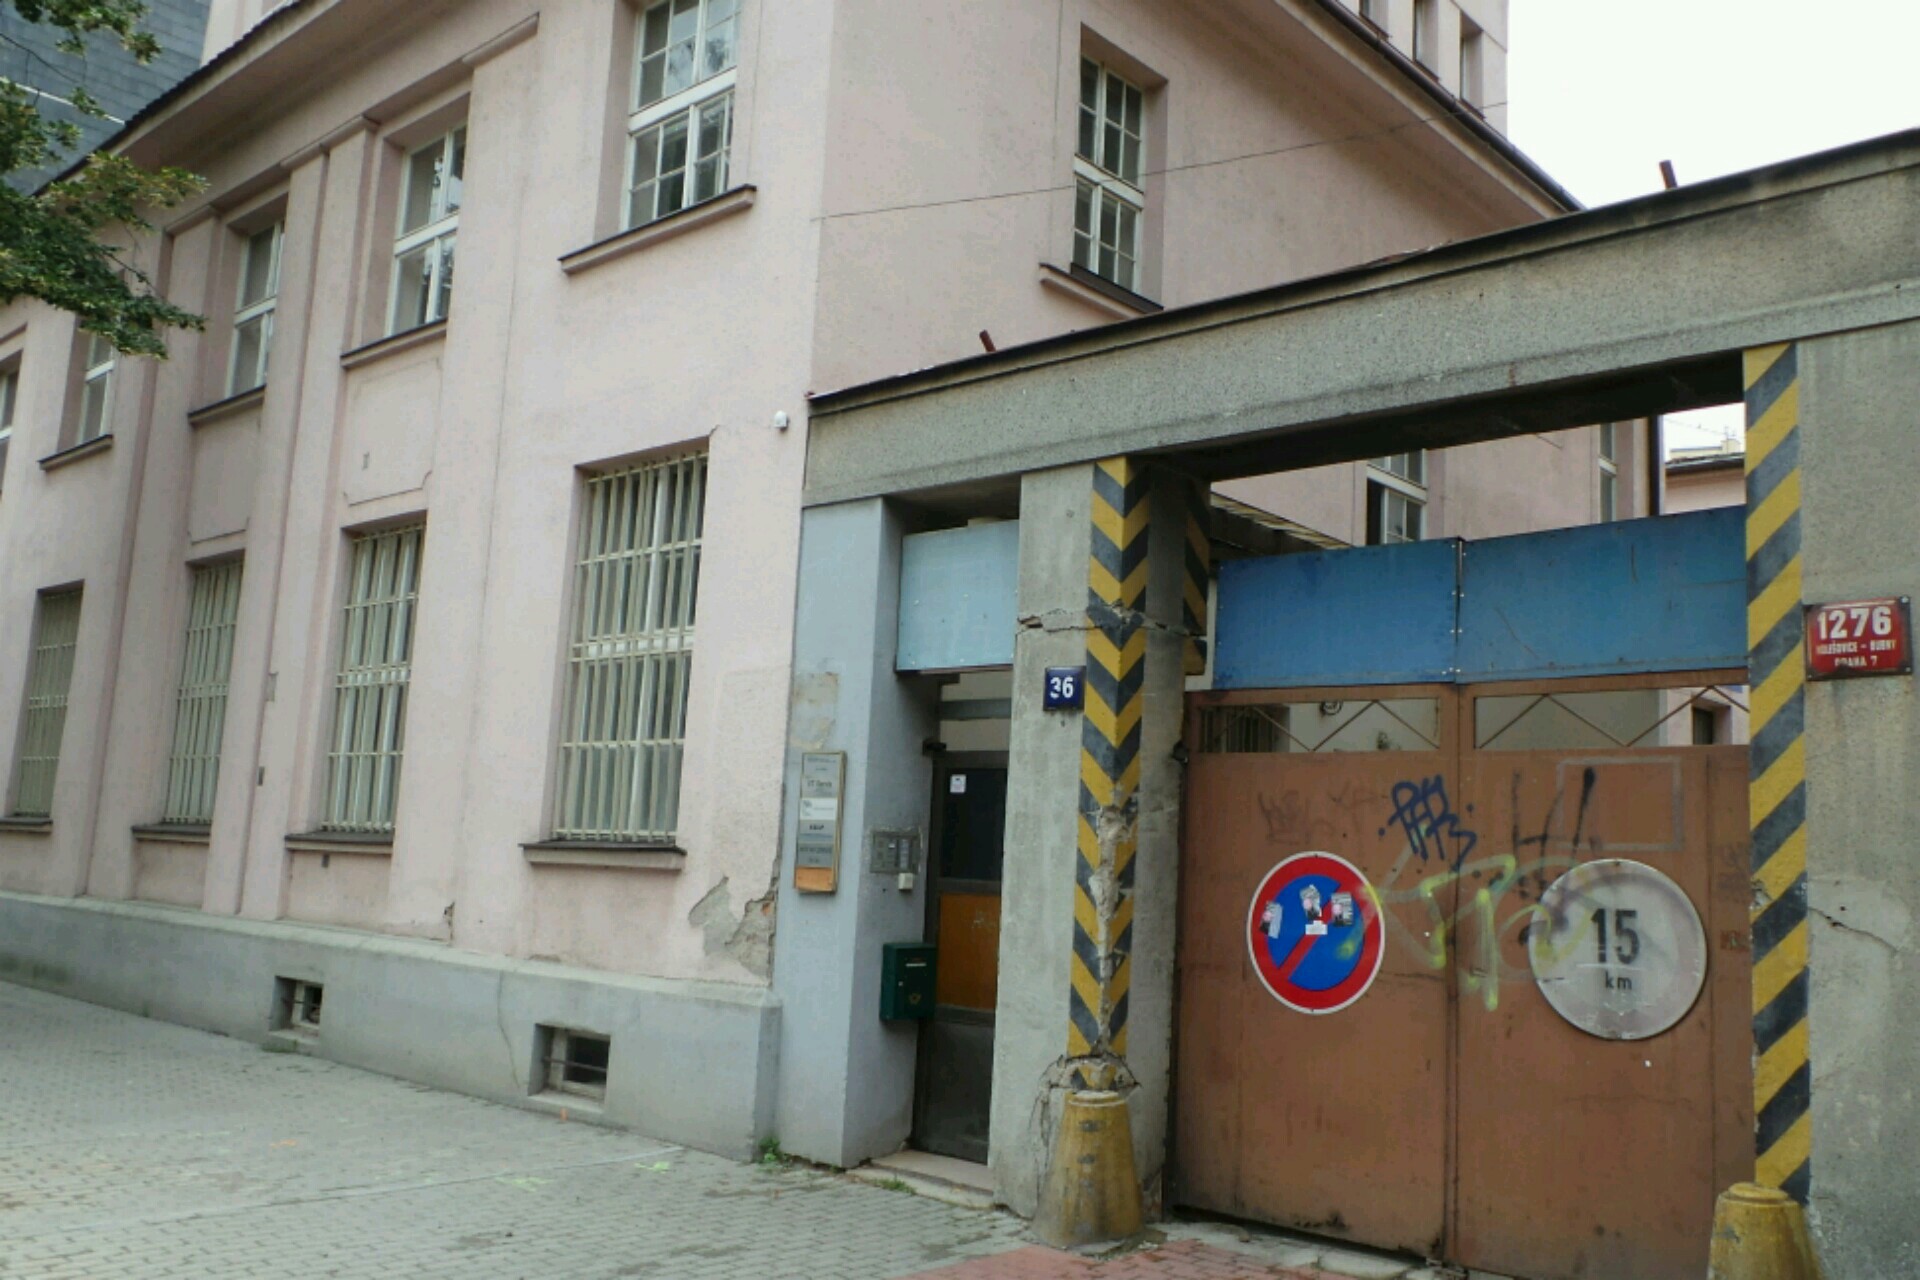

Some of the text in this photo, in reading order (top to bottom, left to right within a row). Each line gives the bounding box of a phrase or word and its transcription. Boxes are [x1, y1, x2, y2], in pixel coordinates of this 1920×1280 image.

[1817, 606, 1892, 640] 1276
[1870, 655, 1878, 666] 7
[1049, 676, 1074, 699] 36
[1591, 907, 1641, 964] 15
[1604, 971, 1633, 991] km
